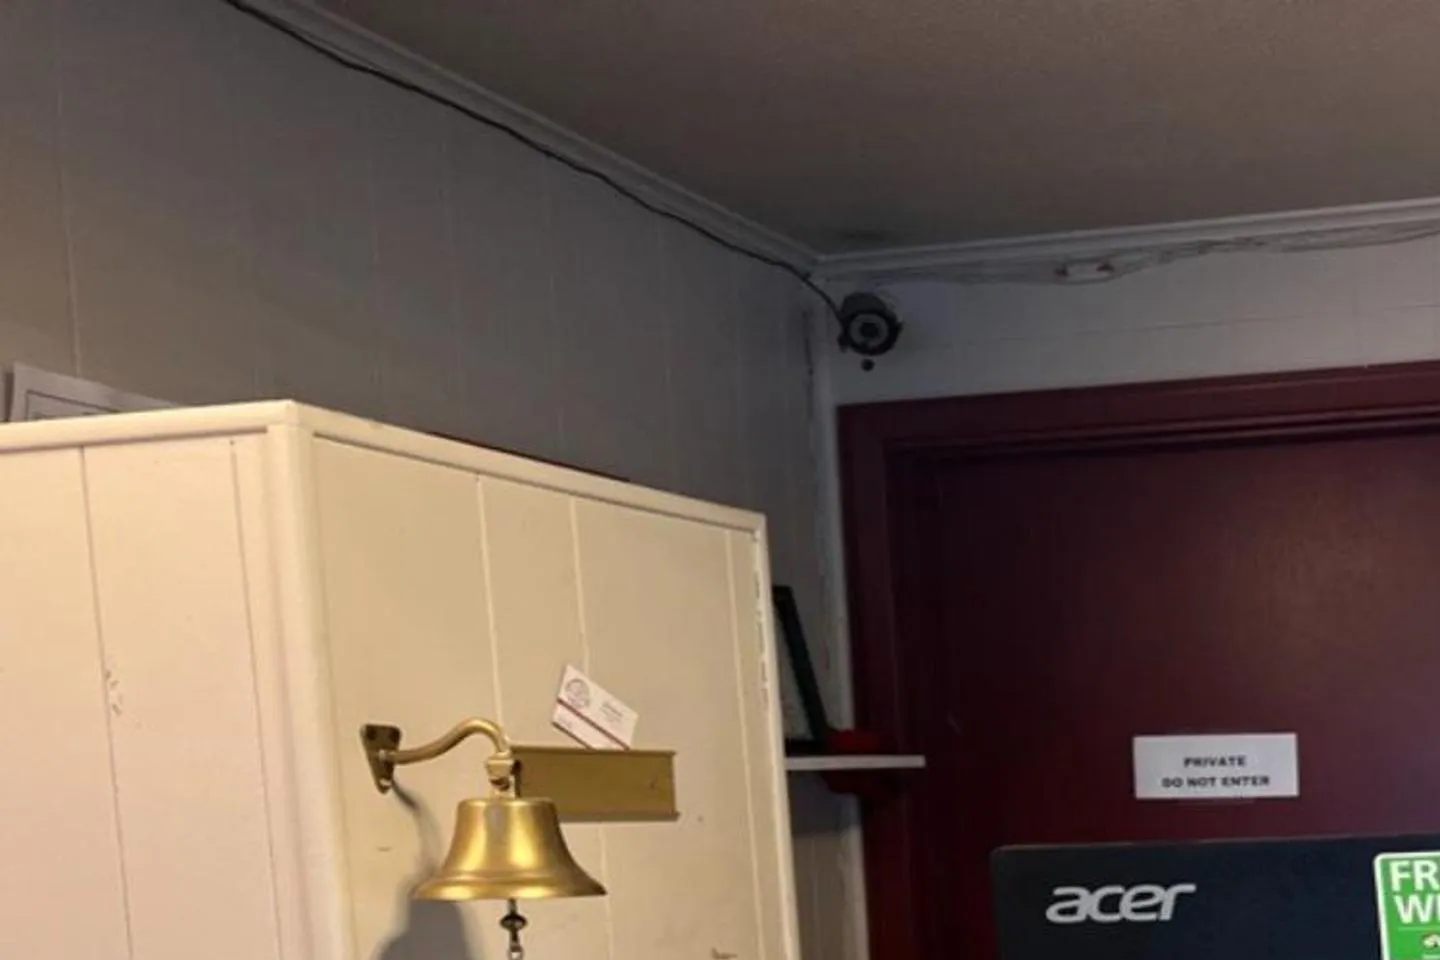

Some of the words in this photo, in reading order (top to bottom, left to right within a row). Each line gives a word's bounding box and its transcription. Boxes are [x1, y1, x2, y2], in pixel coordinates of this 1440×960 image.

[1183, 755, 1246, 768] PRIVATE
[1161, 776, 1183, 788] DO
[1186, 775, 1217, 787] NOT
[1221, 774, 1270, 787] ENTER
[1046, 884, 1197, 923] acer
